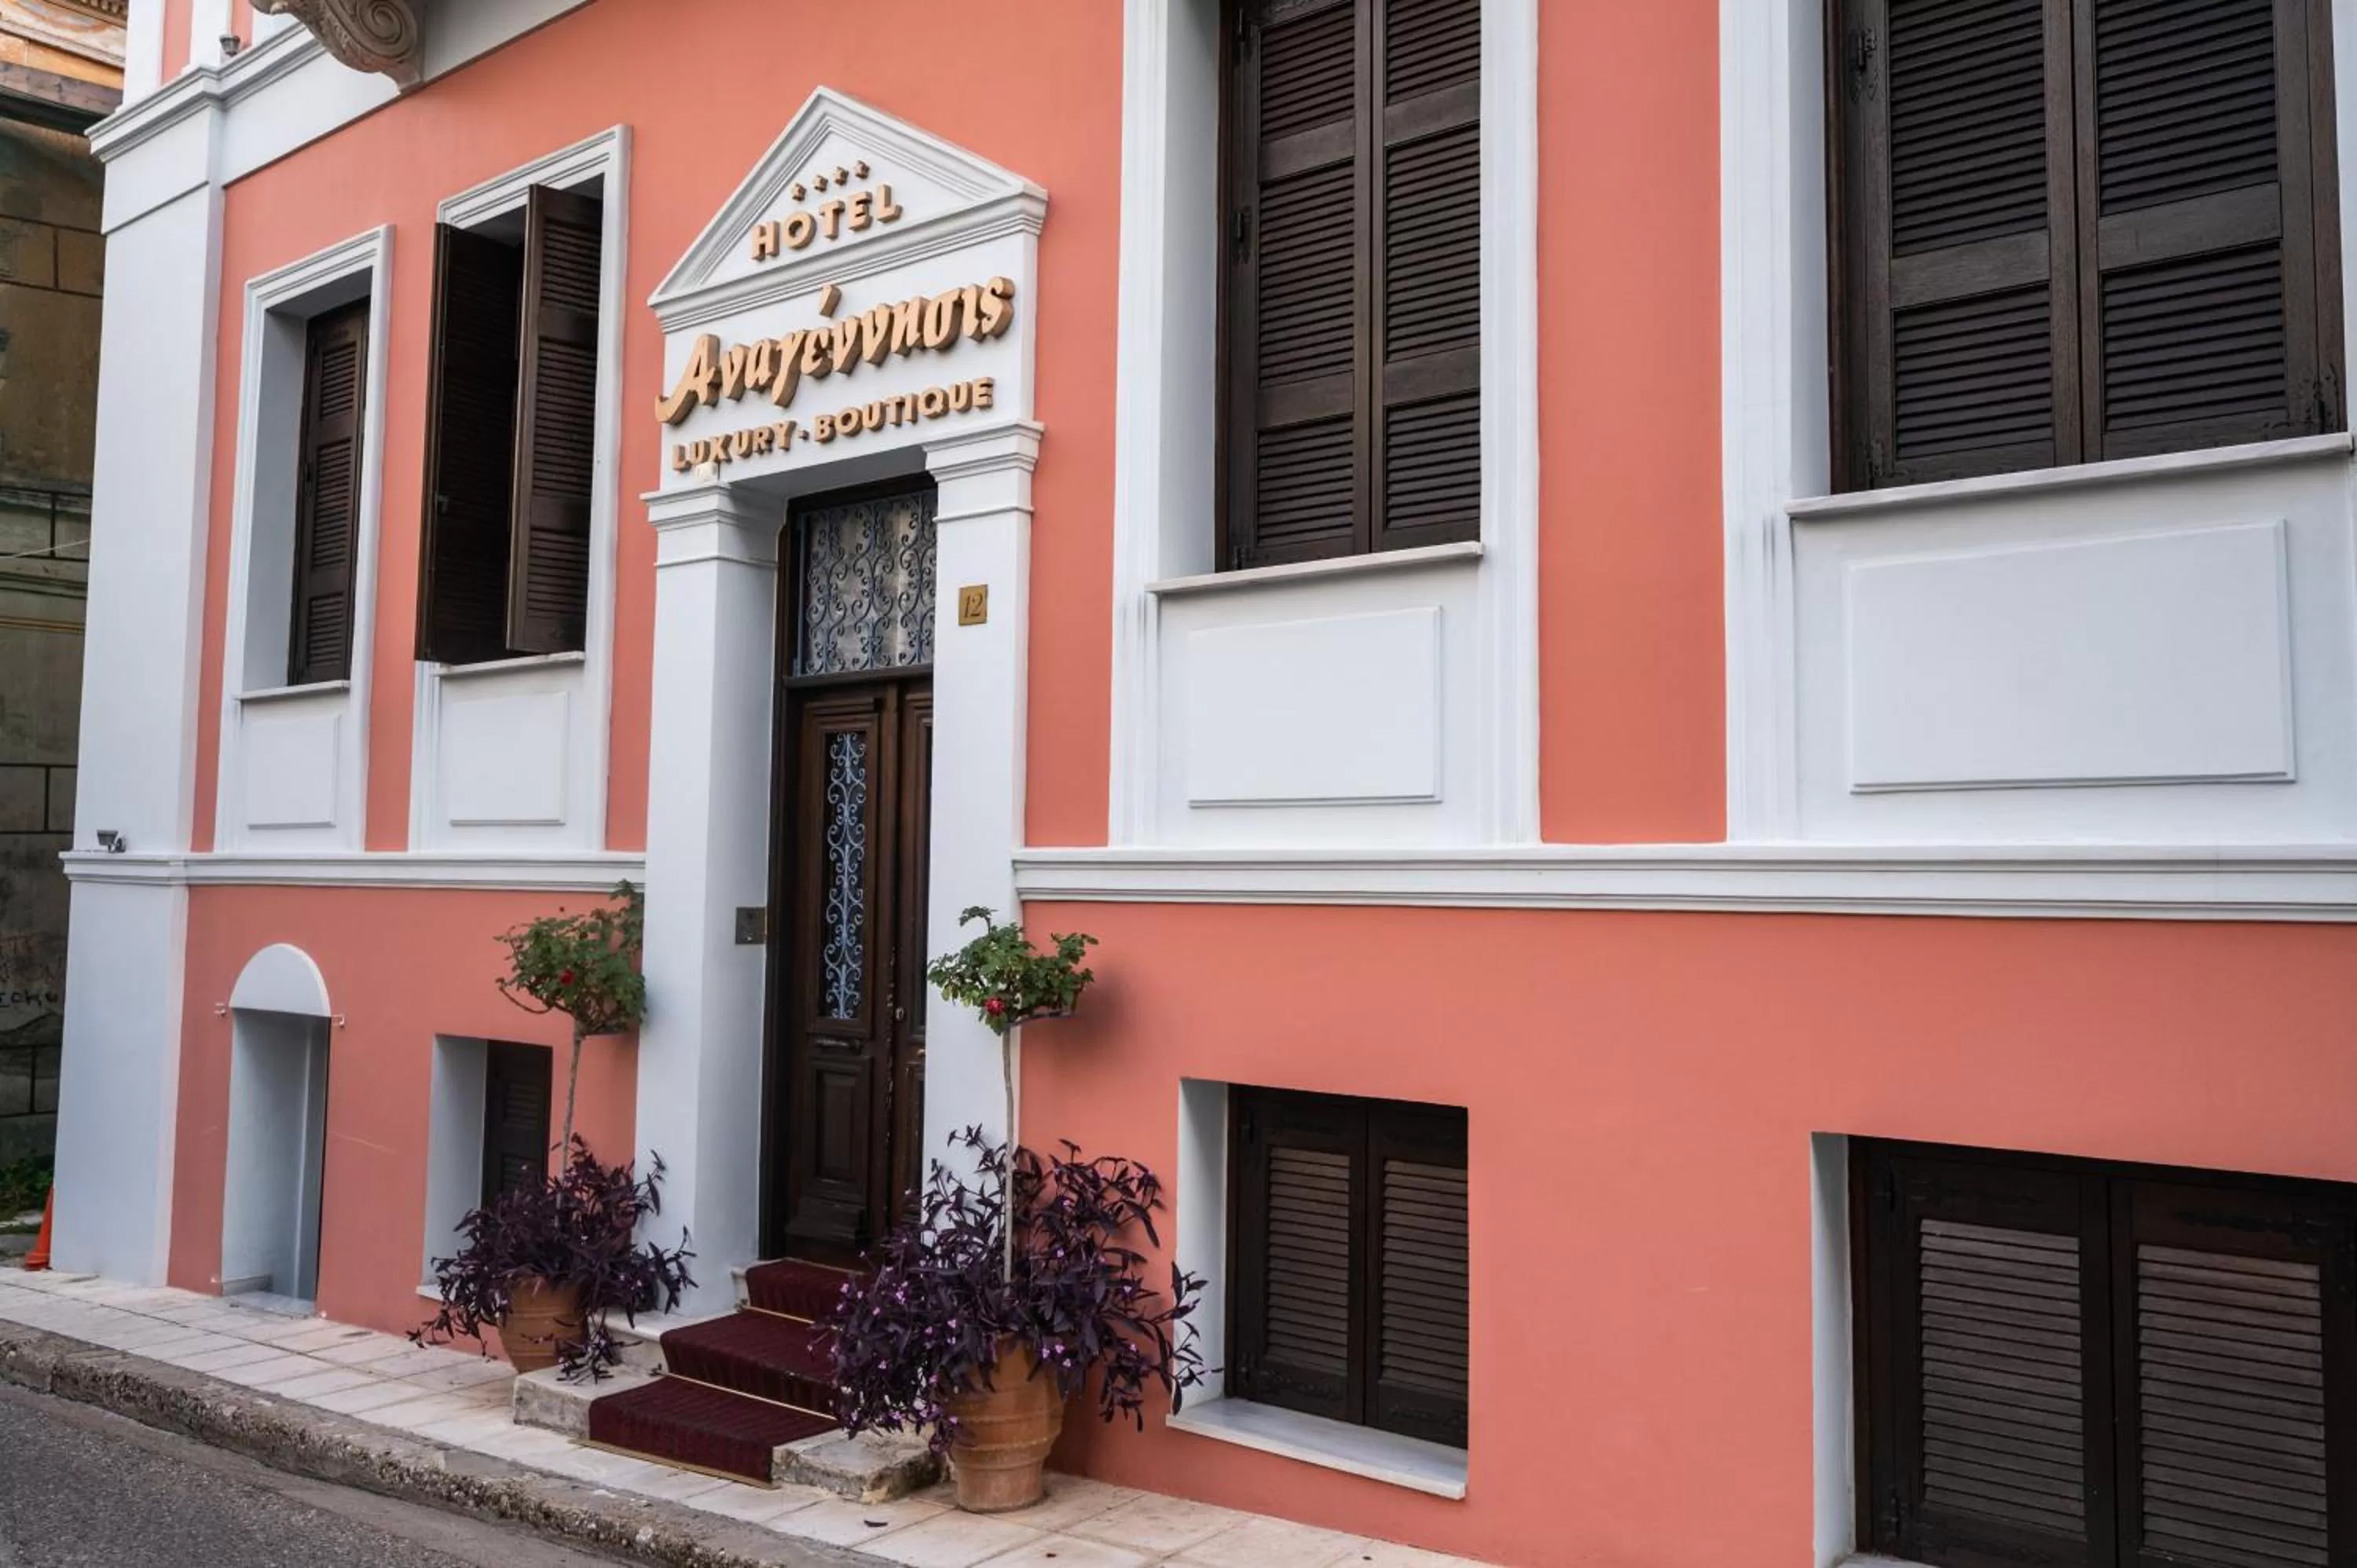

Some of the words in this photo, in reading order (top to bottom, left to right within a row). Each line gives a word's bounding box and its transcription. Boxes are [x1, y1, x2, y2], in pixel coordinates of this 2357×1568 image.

[751, 184, 902, 261] HOTEL
[673, 420, 797, 471] LUXURY
[814, 377, 995, 442] BOUTIQUE
[964, 593, 983, 618] 12
